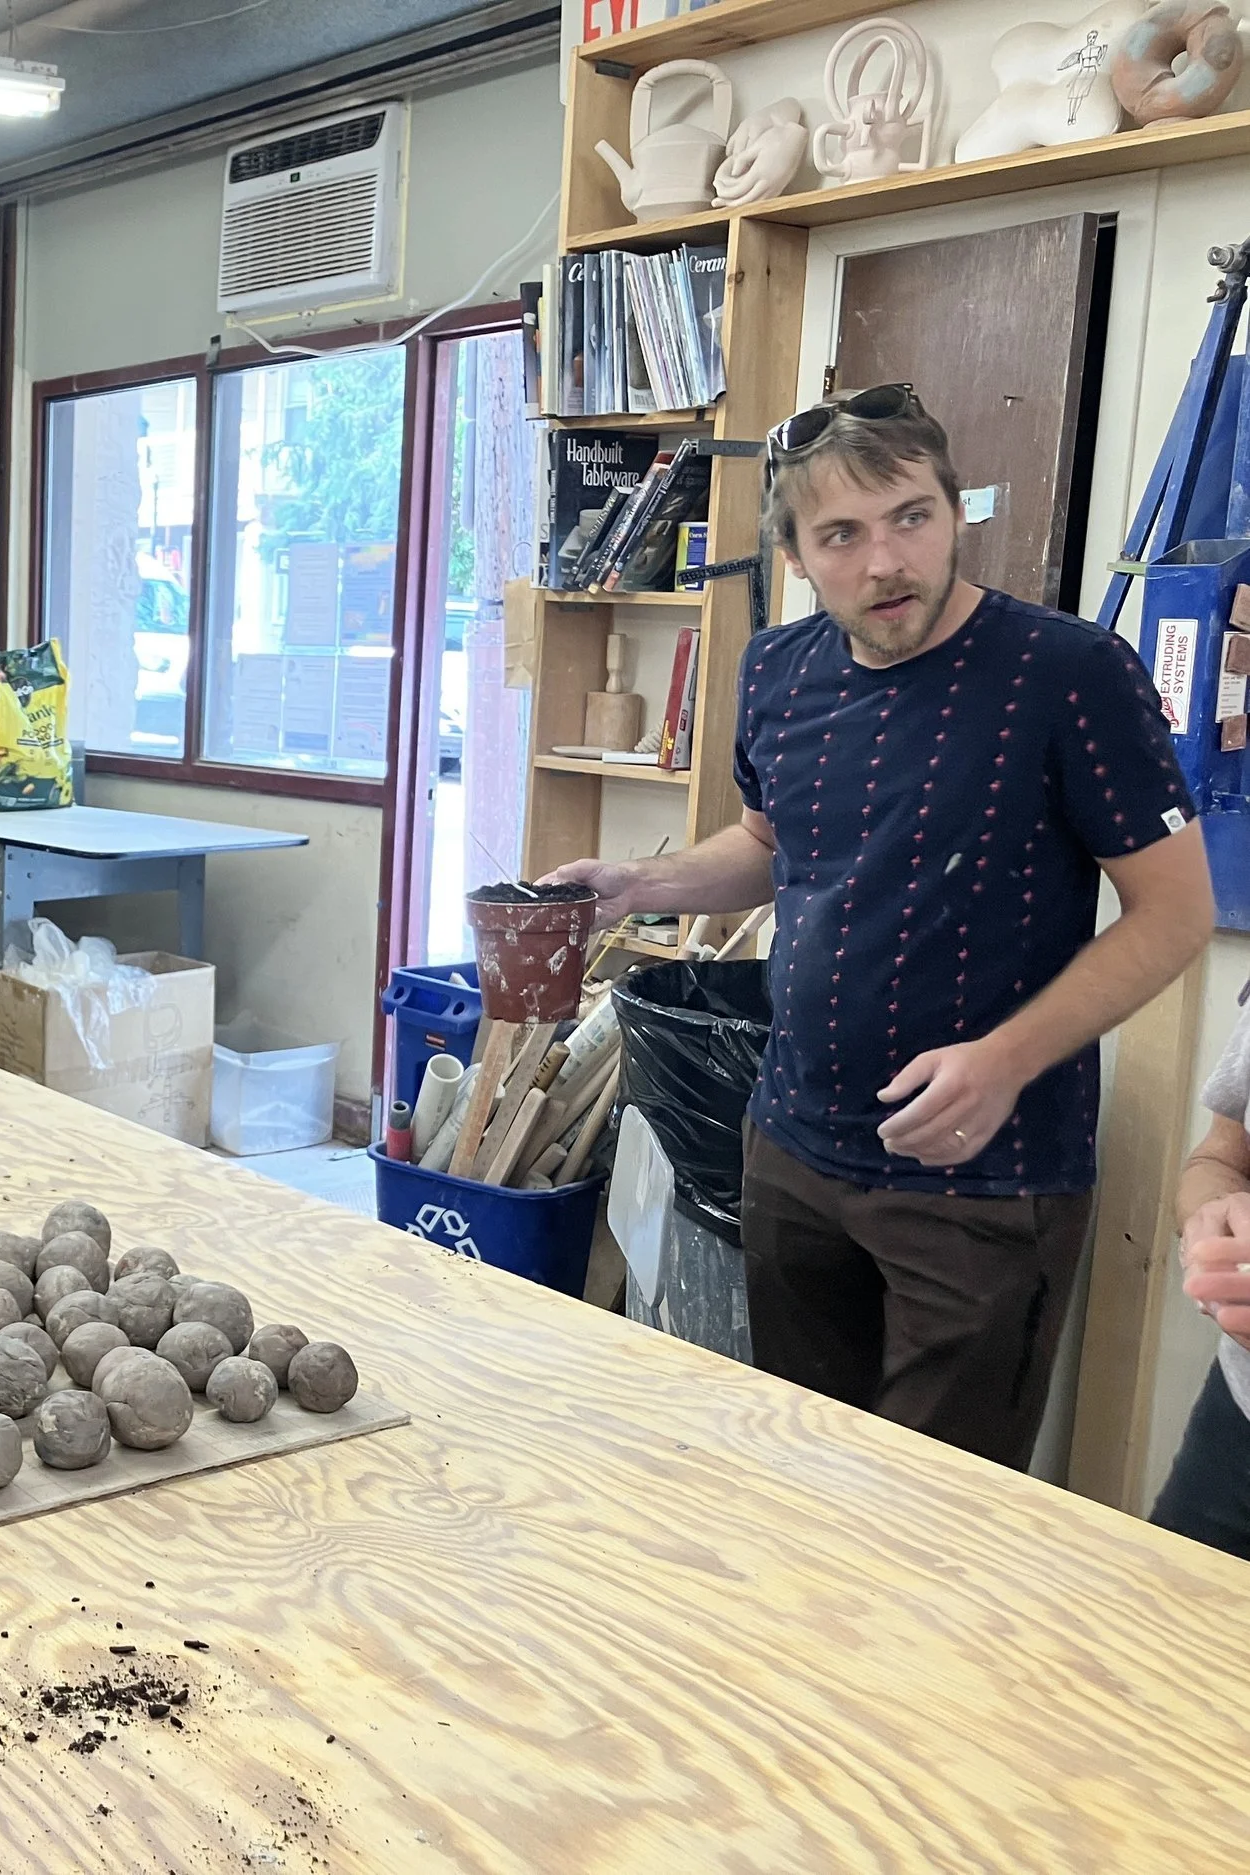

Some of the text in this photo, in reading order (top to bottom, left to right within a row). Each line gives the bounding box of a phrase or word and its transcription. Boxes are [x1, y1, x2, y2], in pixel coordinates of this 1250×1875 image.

[566, 438, 624, 464] Handbuilt
[580, 462, 640, 487] Tableware
[1160, 625, 1177, 694] EXTRUDING
[1173, 635, 1189, 694] SYSTEMS
